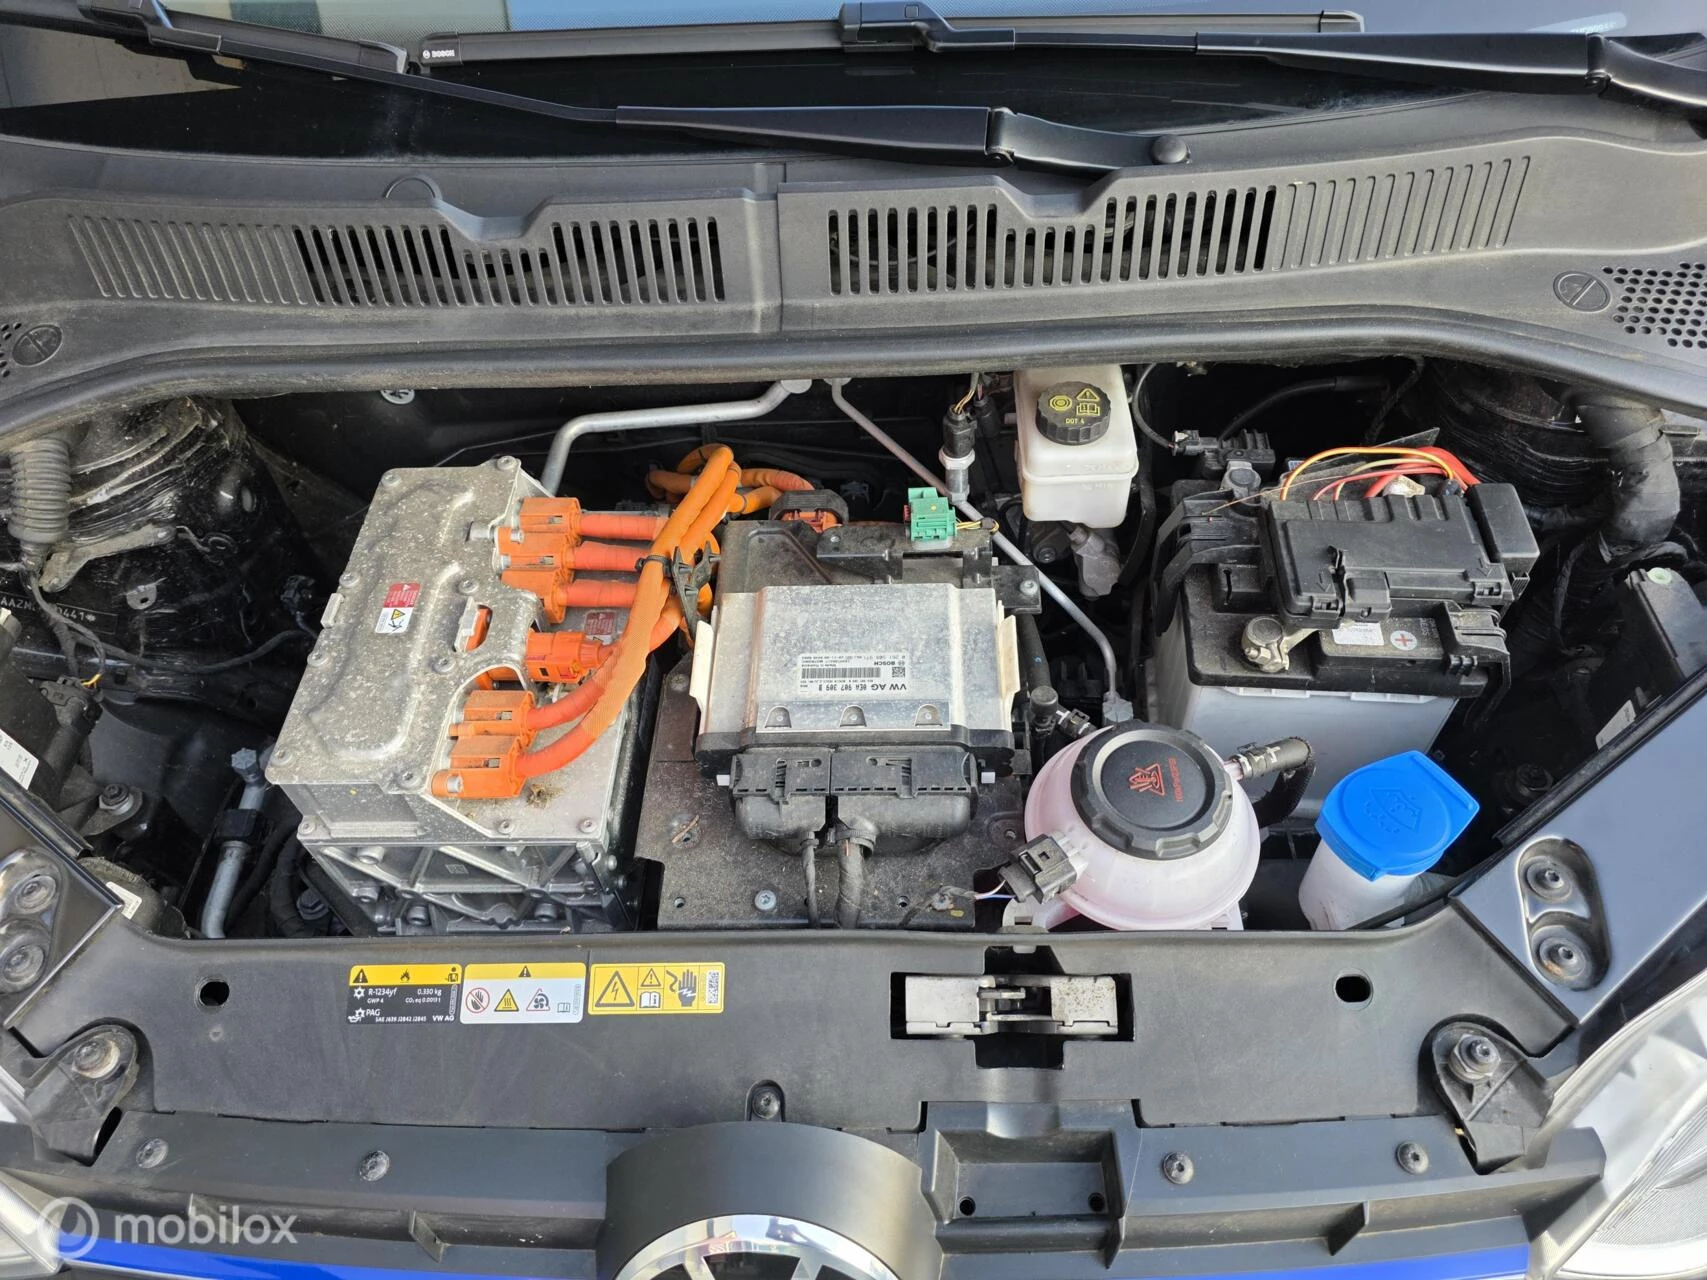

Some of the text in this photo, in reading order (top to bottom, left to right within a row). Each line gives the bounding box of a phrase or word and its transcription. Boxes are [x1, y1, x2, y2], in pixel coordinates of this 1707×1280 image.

[432, 49, 455, 57] BOSCH
[870, 683, 886, 691] AG
[889, 683, 907, 691] VW
[368, 987, 398, 998] R-1234yf
[417, 987, 442, 996] 0.330 kg
[366, 1008, 381, 1016] PAG
[444, 1014, 455, 1022] AG
